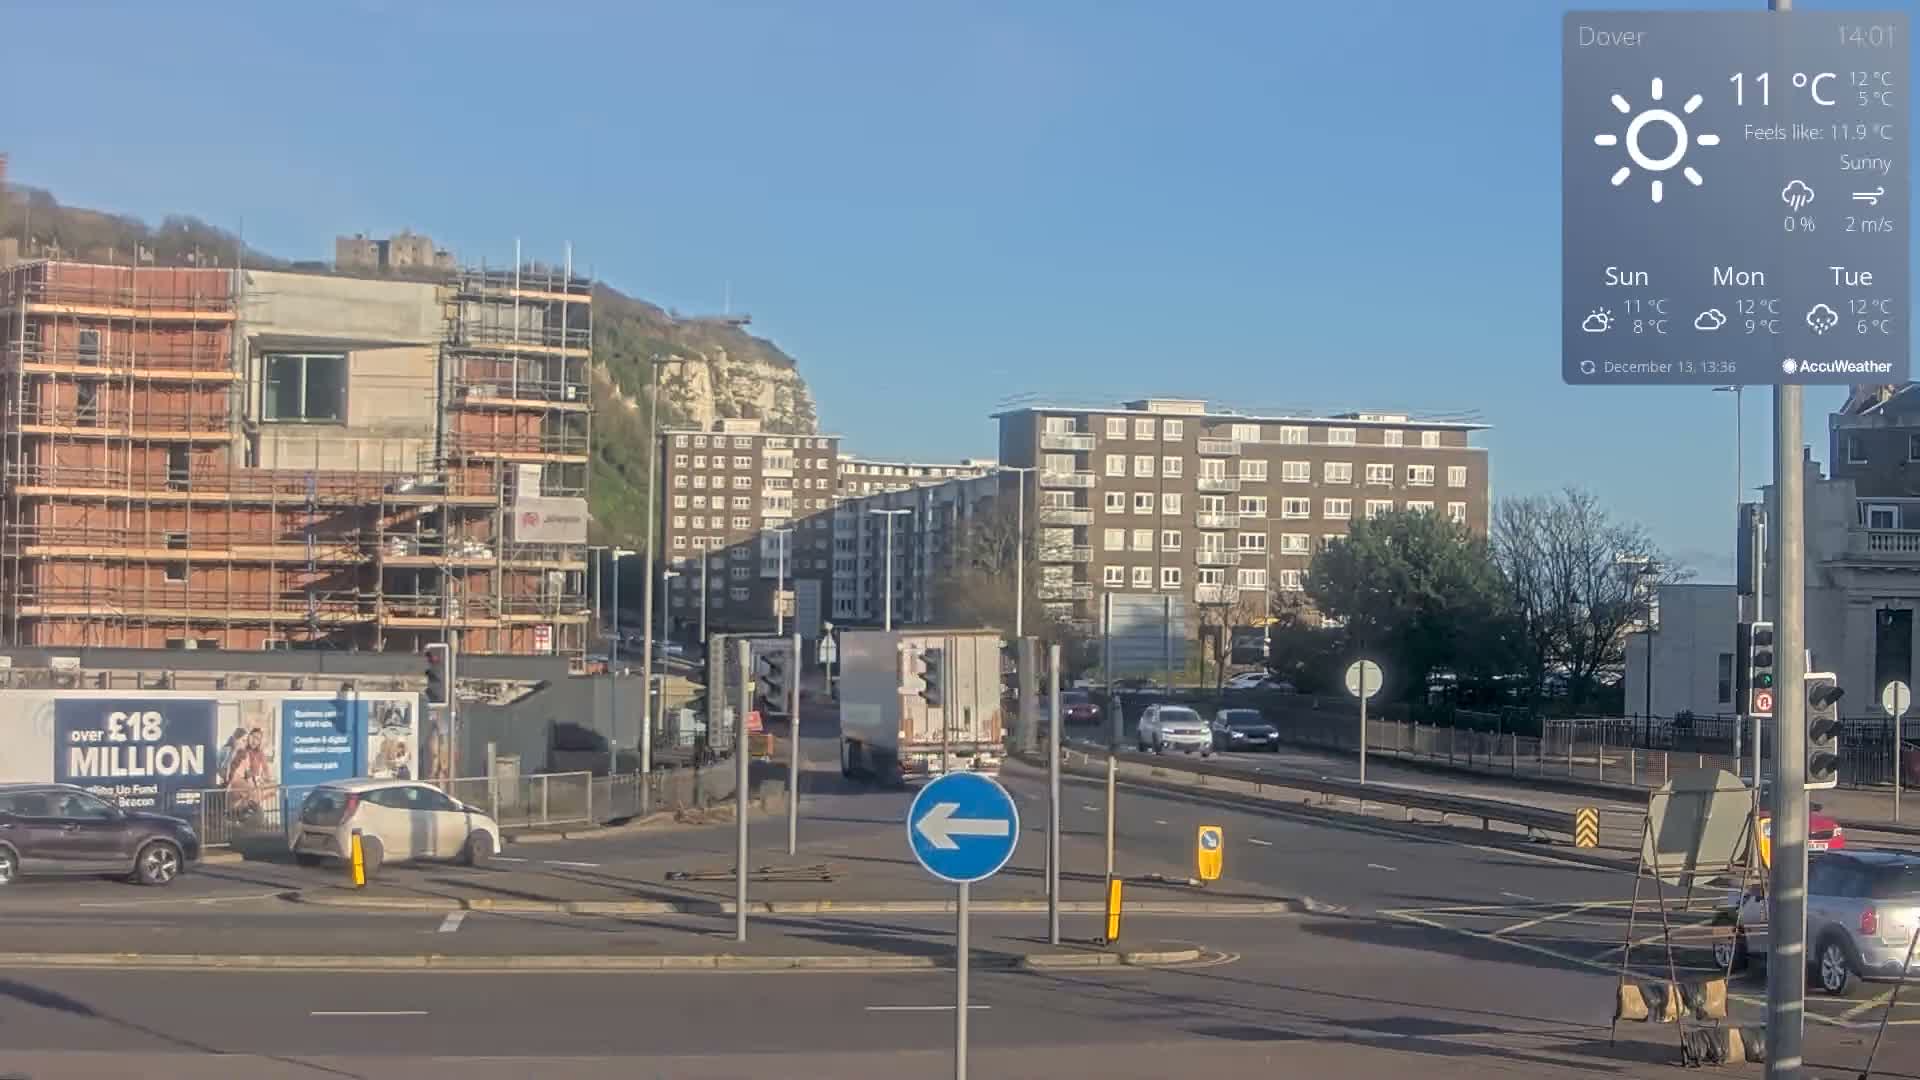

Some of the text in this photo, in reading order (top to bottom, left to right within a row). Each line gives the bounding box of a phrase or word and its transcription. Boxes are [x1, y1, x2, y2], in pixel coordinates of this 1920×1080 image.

[71, 711, 162, 742] over £18
[71, 745, 204, 776] MILLION
